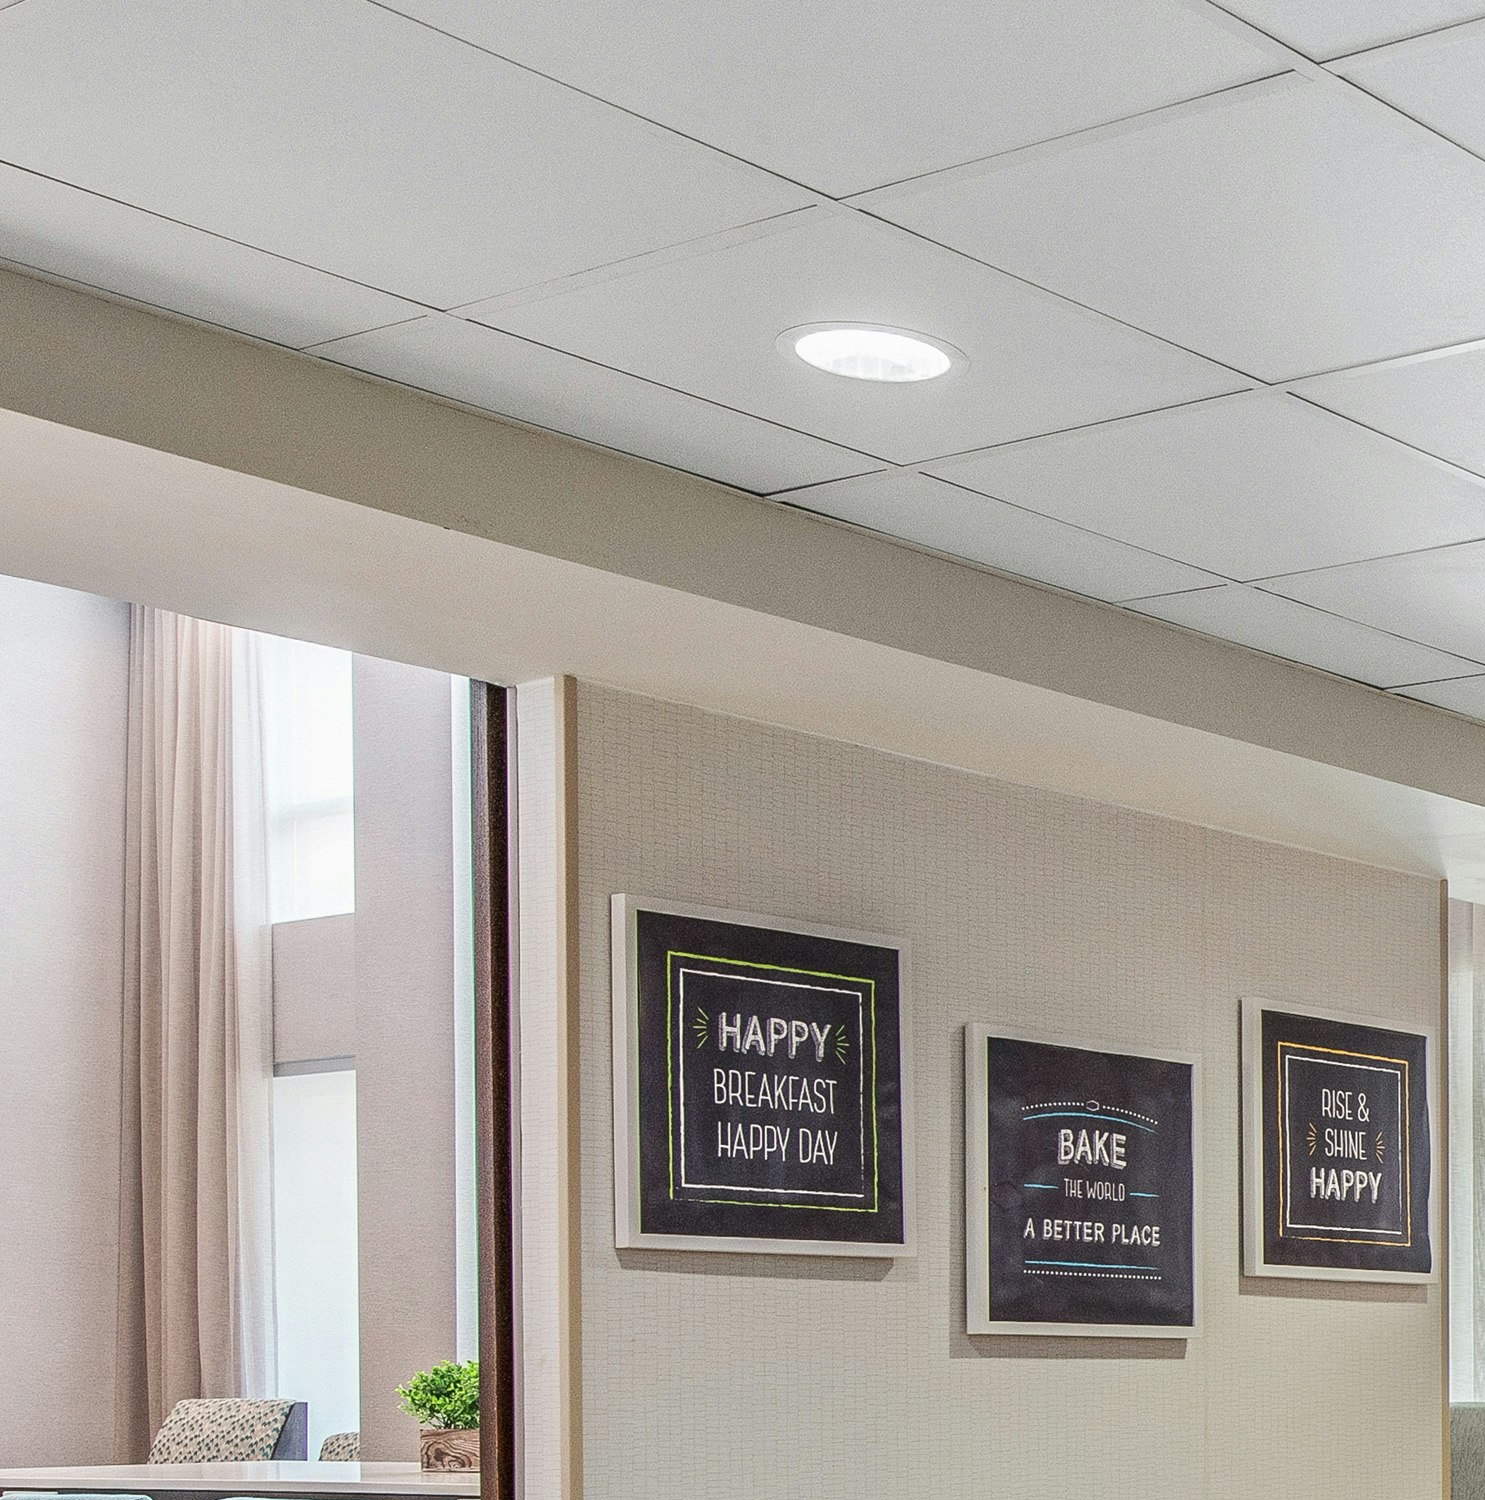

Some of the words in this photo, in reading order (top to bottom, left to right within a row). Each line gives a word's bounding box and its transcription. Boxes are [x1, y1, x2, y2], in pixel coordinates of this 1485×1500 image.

[717, 1011, 832, 1062] HAPPY
[712, 1067, 838, 1115] BREAKFAST
[1321, 1088, 1353, 1121] RISE
[1357, 1092, 1370, 1123] &
[716, 1120, 791, 1163] HAPPY
[798, 1127, 839, 1166] DAY
[1057, 1128, 1128, 1170] BAKE
[1324, 1127, 1368, 1161] SHINE
[1063, 1177, 1083, 1199] THE
[1085, 1180, 1126, 1202] WORLD
[1309, 1166, 1383, 1204] HAPPY
[1023, 1217, 1035, 1240] A
[1042, 1218, 1105, 1245] BETTER
[1111, 1223, 1161, 1247] PLACE
